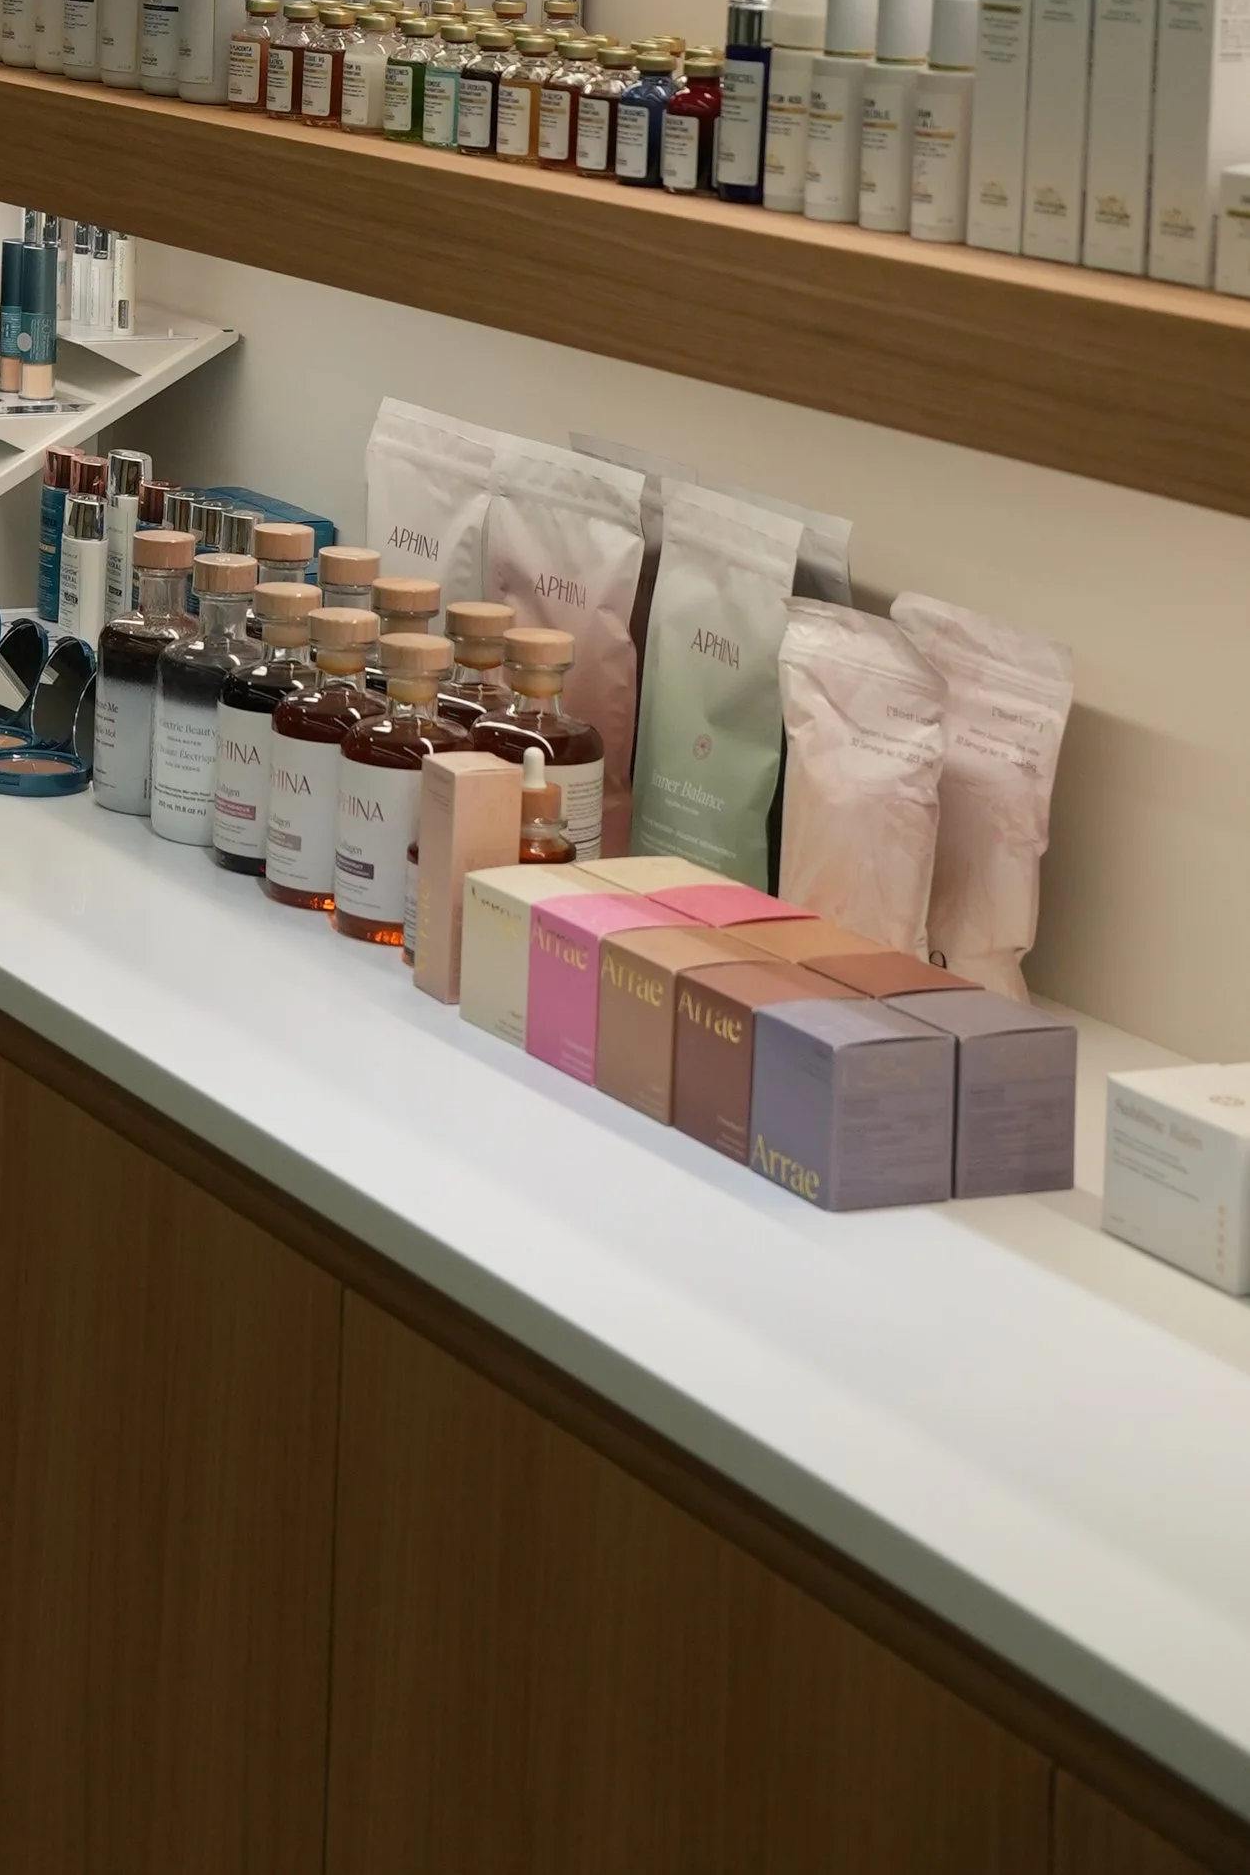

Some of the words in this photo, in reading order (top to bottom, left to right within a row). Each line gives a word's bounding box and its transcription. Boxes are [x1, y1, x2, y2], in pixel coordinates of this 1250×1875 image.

[387, 525, 440, 562] APHINA
[534, 573, 587, 610] APHINA
[690, 627, 741, 671] APHINA
[681, 780, 726, 812] Balance
[531, 919, 589, 971] Arrae
[601, 952, 665, 1008] Arrae
[677, 990, 743, 1044] Arrae
[751, 1133, 821, 1200] Arrae
